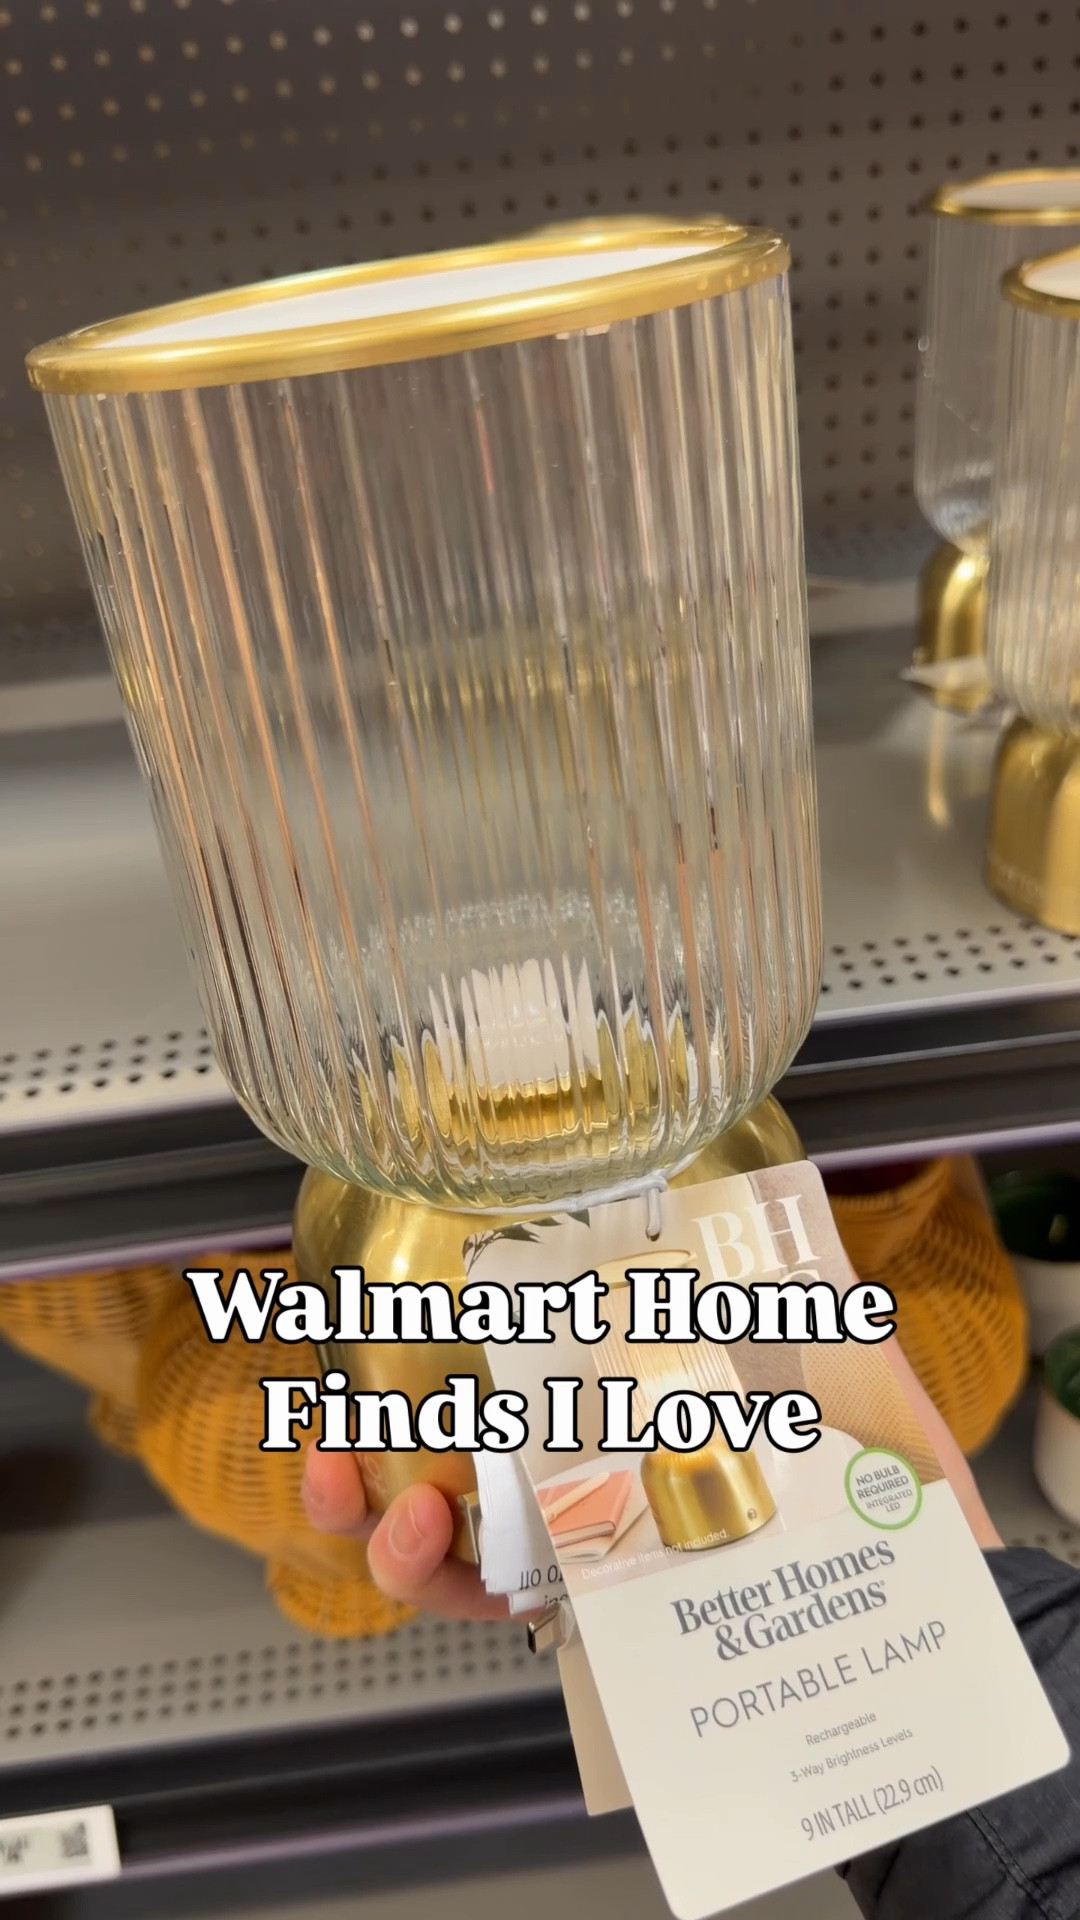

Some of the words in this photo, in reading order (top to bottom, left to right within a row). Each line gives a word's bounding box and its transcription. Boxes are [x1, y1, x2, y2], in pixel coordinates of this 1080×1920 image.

[855, 1473, 873, 1486] NO
[873, 1465, 900, 1480] BULB
[856, 1475, 909, 1499] REQUIRED
[865, 1488, 913, 1509] INTEGRATED
[885, 1502, 901, 1513] LED
[581, 1556, 637, 1580] Decorative
[638, 1549, 665, 1564] items
[665, 1541, 684, 1555] not
[684, 1528, 731, 1549] included.
[670, 1579, 775, 1635] Better
[771, 1540, 895, 1601] Homes
[715, 1624, 749, 1661] &
[690, 1654, 858, 1738] PORTABLE
[860, 1620, 946, 1675] LAMP
[805, 1712, 877, 1746] Rechargeable
[789, 1764, 825, 1783] 3-Way
[825, 1741, 880, 1769] Brightness
[879, 1727, 914, 1748] Levels
[800, 1817, 815, 1841] 9
[812, 1808, 836, 1837] IN
[831, 1794, 876, 1827] TALL
[872, 1778, 913, 1816] (22.9
[913, 1765, 944, 1796] cm)
